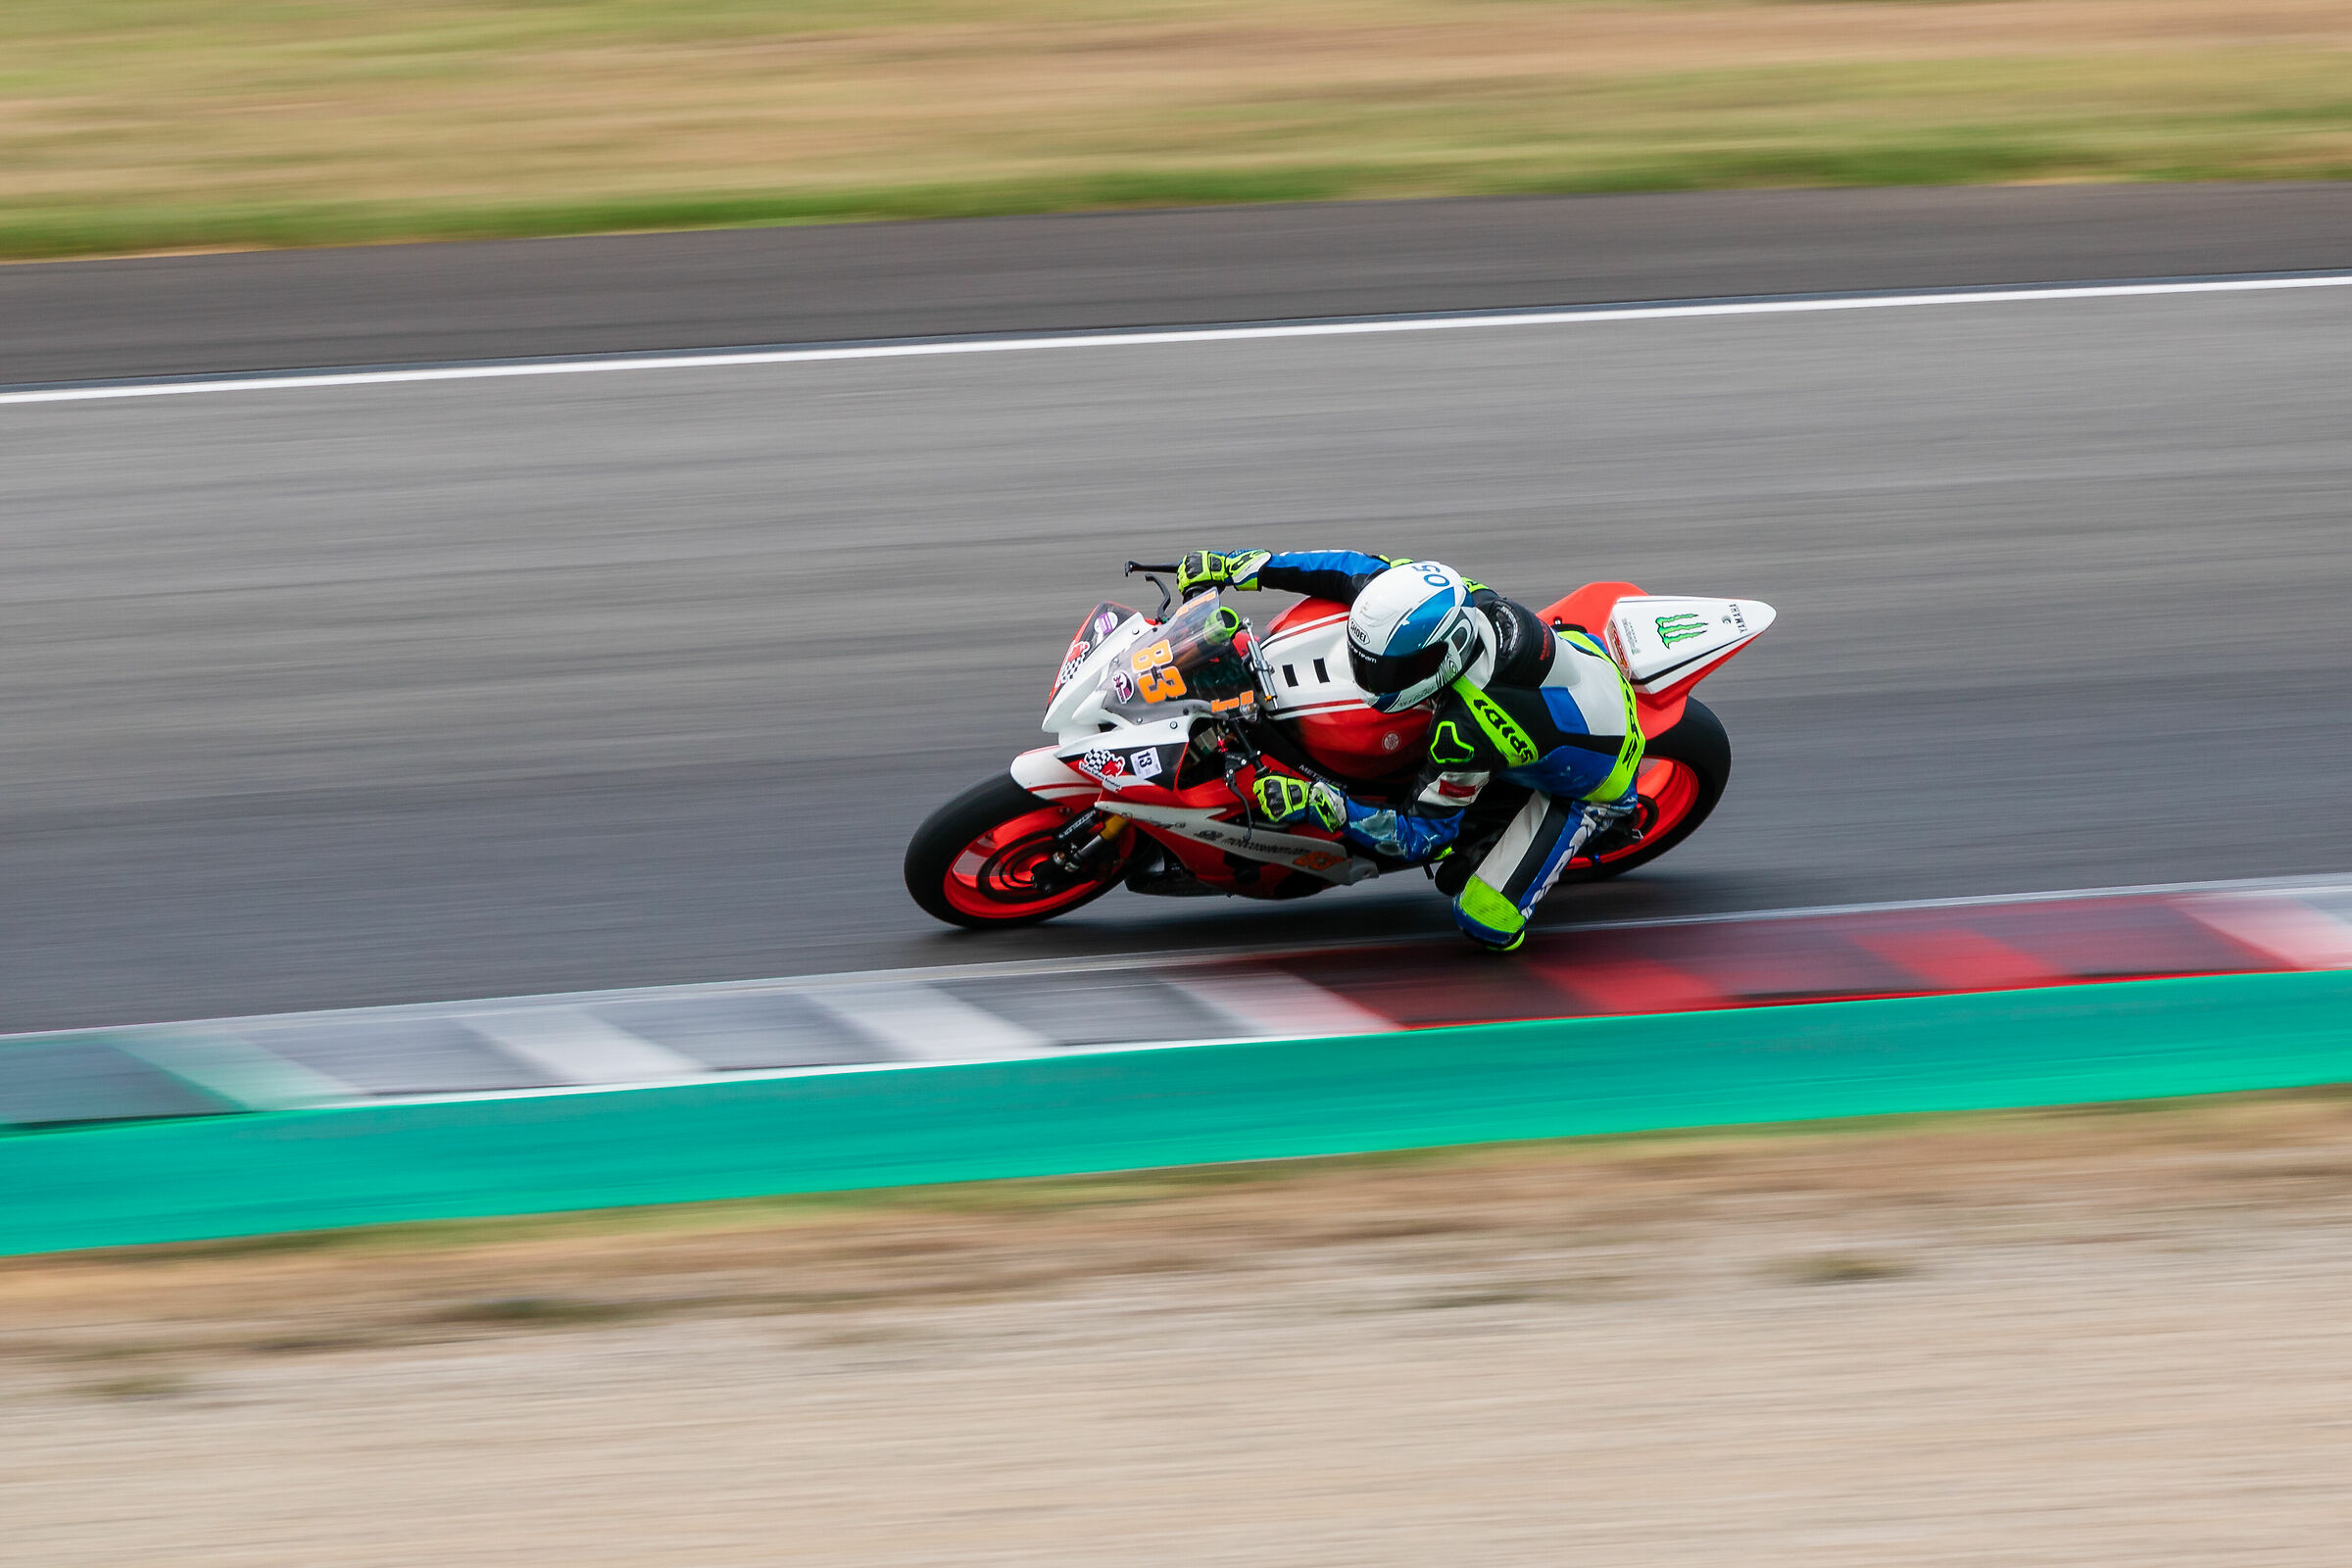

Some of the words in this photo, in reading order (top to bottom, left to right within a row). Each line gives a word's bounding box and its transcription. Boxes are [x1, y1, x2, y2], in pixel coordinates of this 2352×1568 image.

[1411, 564, 1450, 587] 05
[1349, 620, 1367, 644] SHOEI
[1729, 603, 1748, 634] YAMAHA
[1131, 639, 1188, 705] 83
[1473, 698, 1534, 764] SPIDI
[1137, 750, 1153, 768] 13
